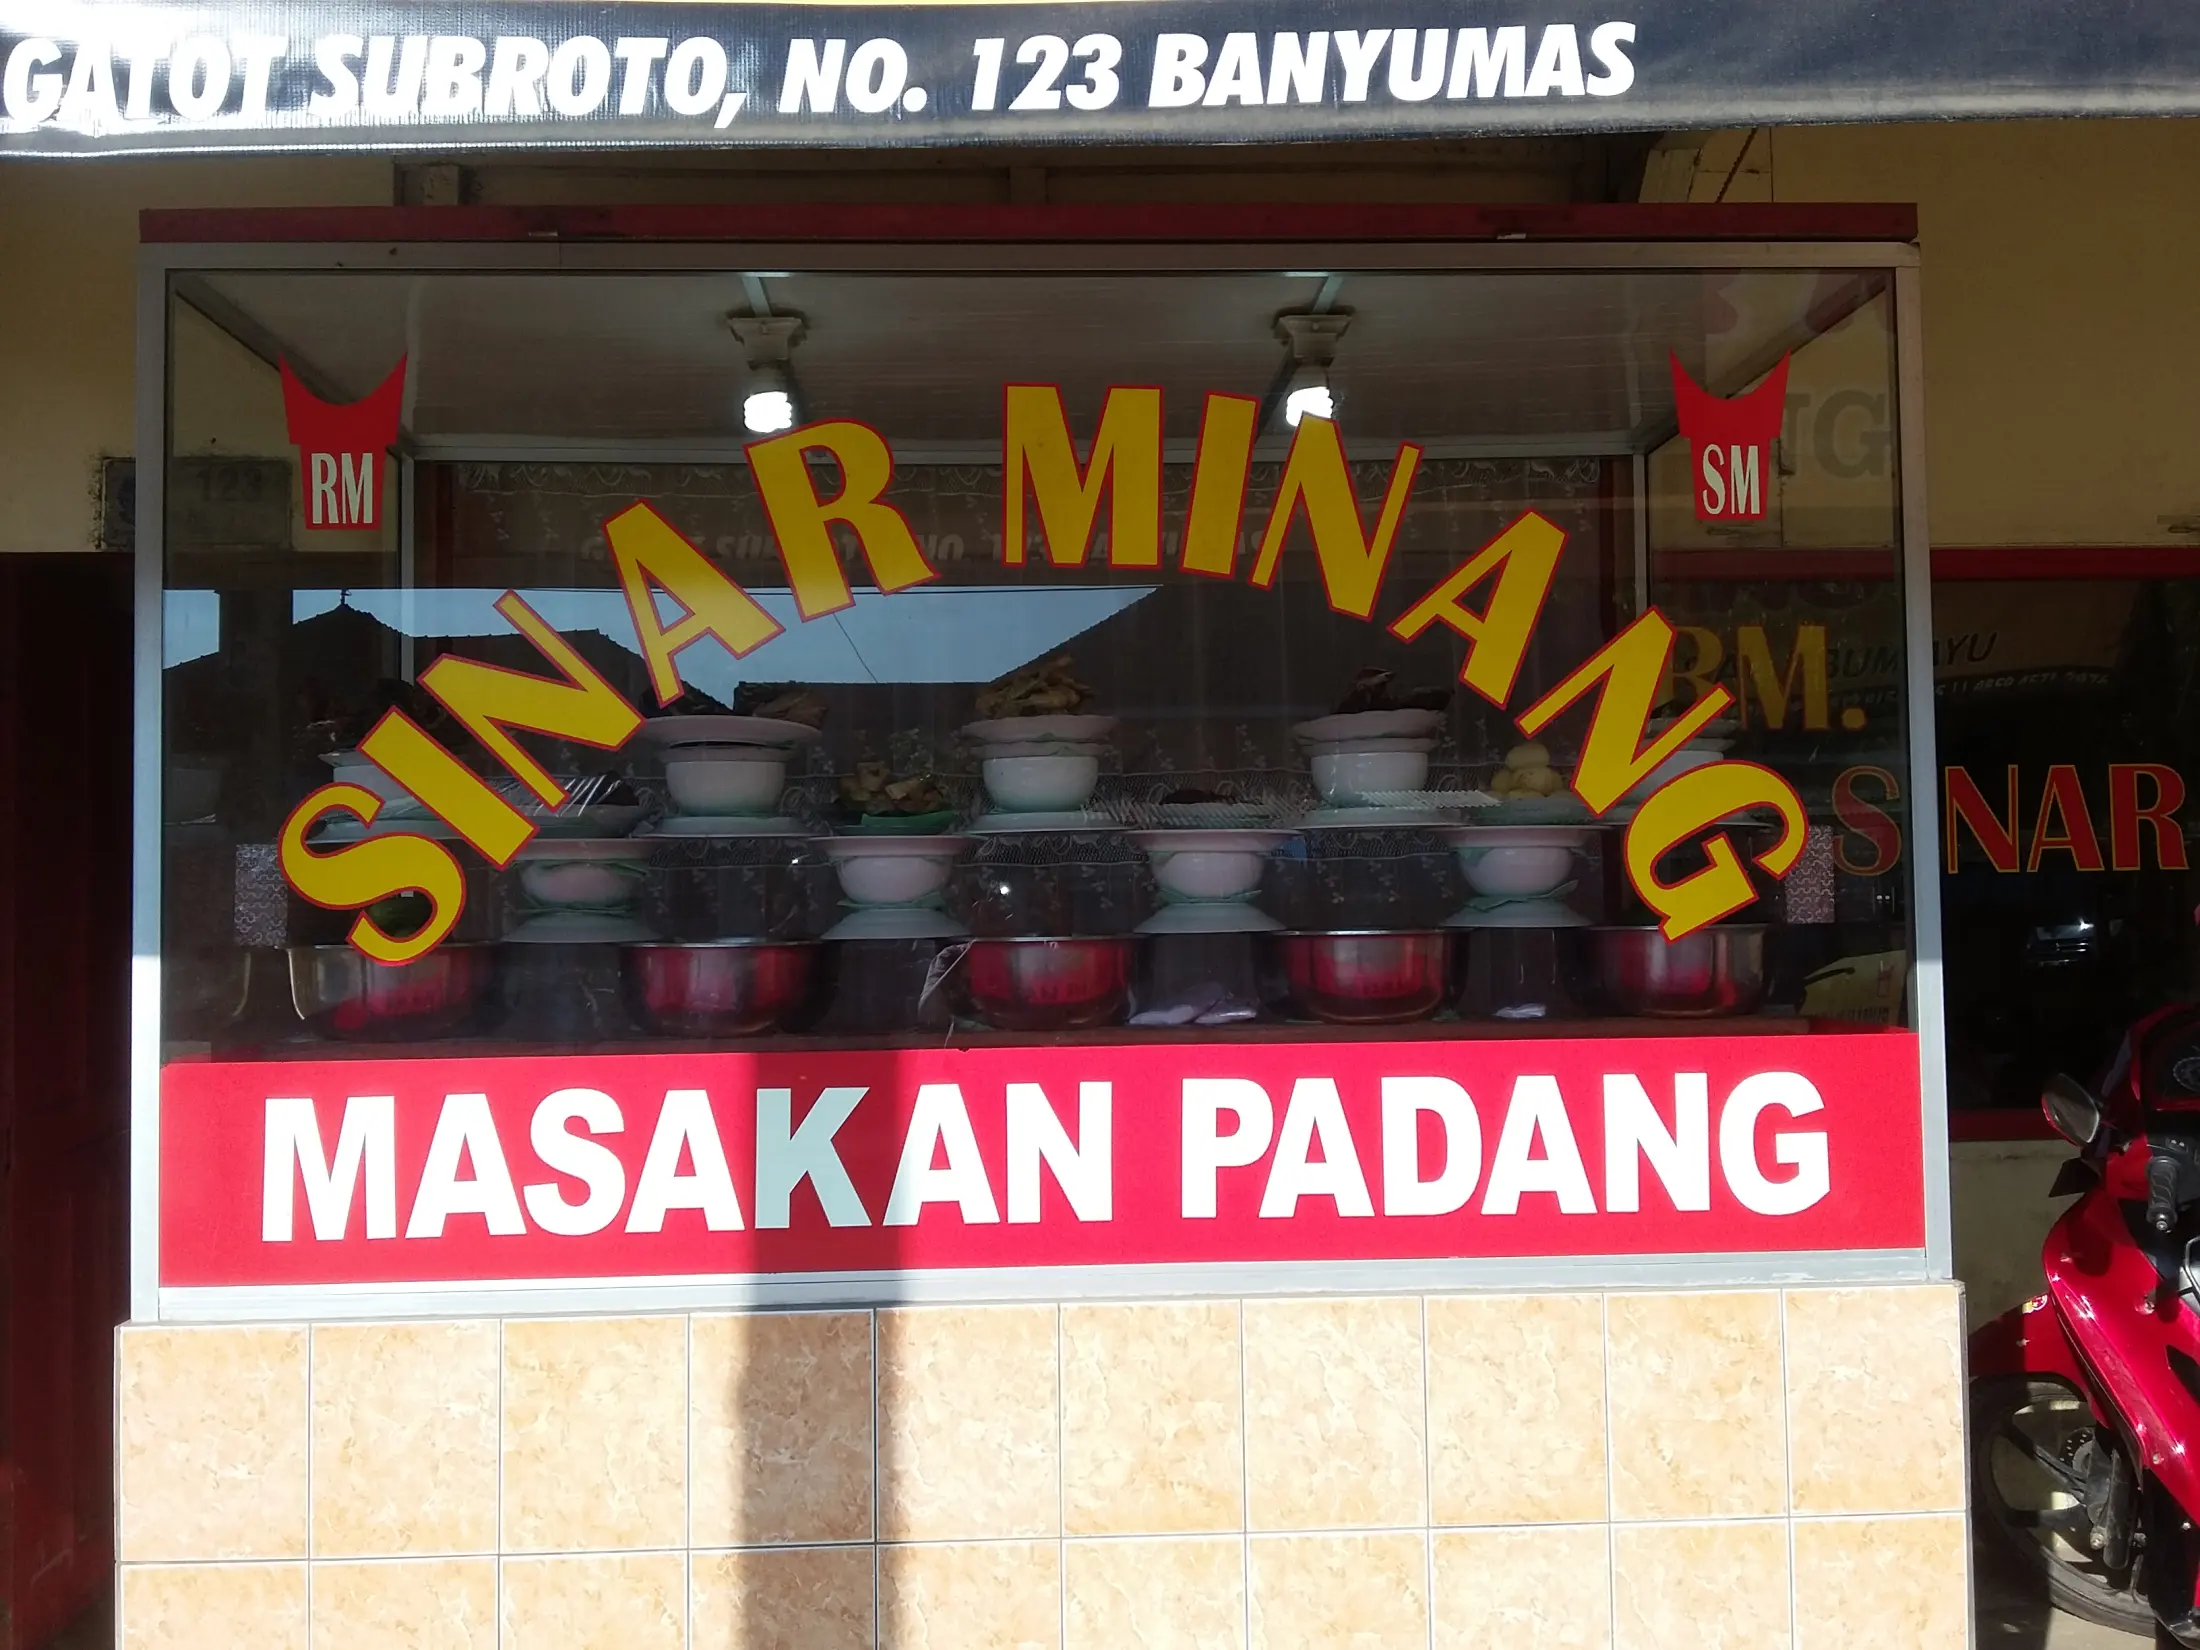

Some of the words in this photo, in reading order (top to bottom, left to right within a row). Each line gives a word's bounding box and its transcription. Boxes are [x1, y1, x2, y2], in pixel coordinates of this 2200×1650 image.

[2, 36, 290, 122] GATOT
[310, 36, 748, 130] SUBROTO,
[778, 37, 928, 115] NO.
[968, 35, 1123, 113] 123
[1148, 22, 1636, 110] BANYUMAS
[311, 452, 374, 525] RM
[1702, 443, 1761, 516] SM
[277, 417, 942, 967] SINAR
[1001, 382, 1810, 944] MINANG
[1831, 763, 2191, 877] SNAR
[261, 1080, 1114, 1243] MASAKAN
[1180, 1071, 1831, 1221] PADANG
